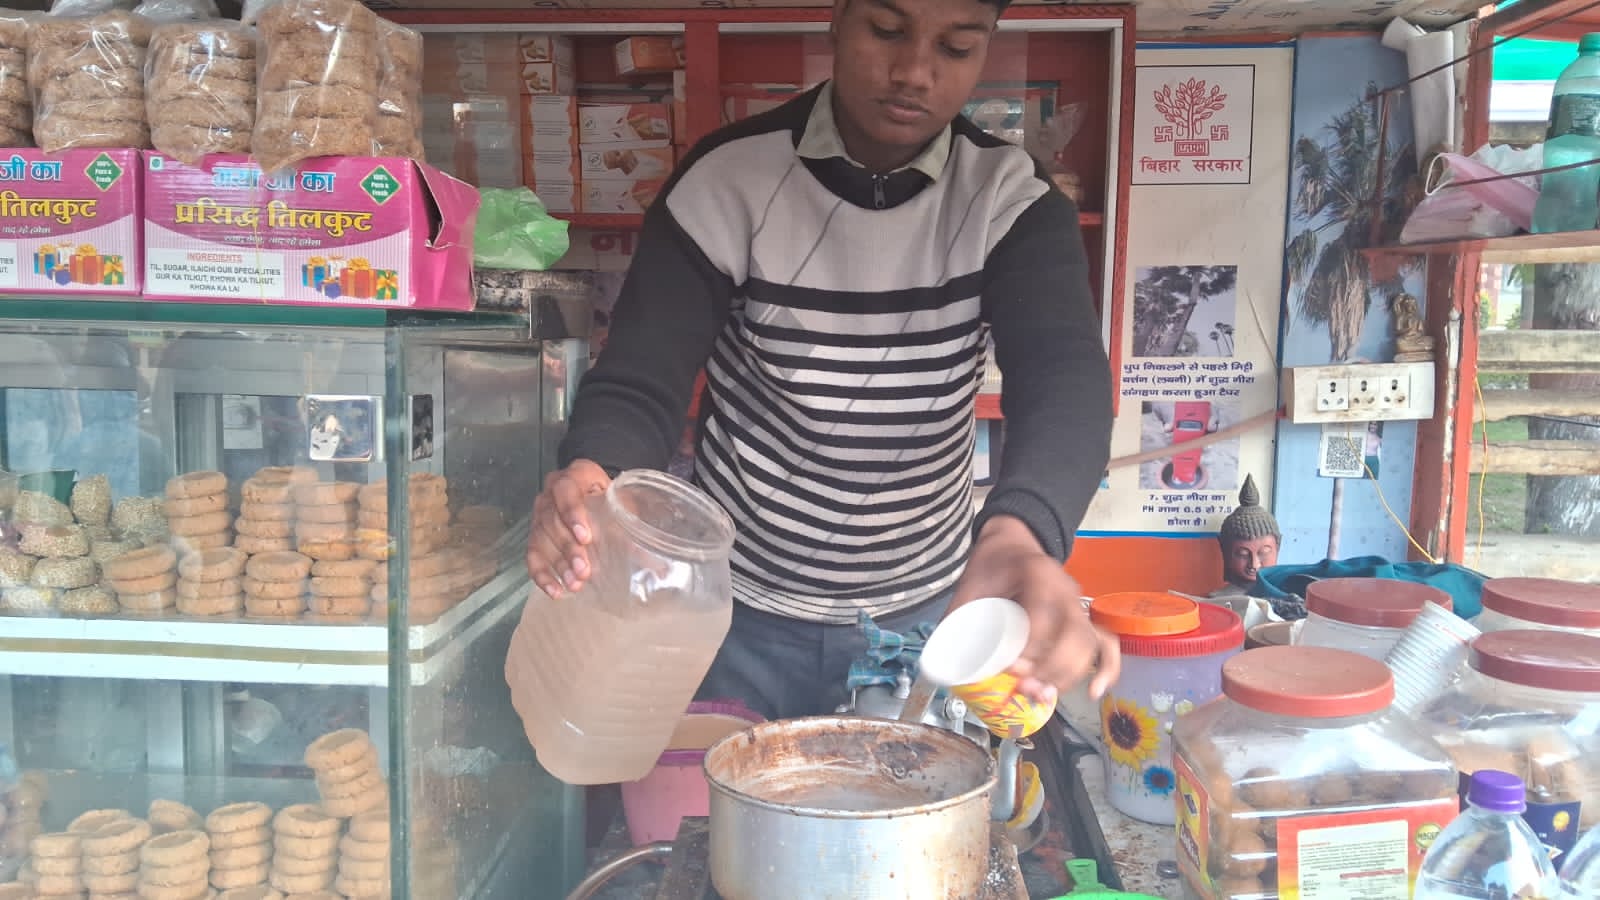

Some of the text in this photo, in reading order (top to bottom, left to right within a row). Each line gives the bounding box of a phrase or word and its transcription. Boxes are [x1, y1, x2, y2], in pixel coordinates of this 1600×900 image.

[1140, 156, 1243, 173] बिहार सरकार
[30, 160, 62, 181] का
[301, 171, 336, 192] का
[0, 190, 97, 224] तिलकुट
[175, 197, 373, 237] प्रसिद्ध तिलकुट
[187, 252, 242, 262] INGREDIENTS
[1143, 362, 1185, 371] निकलने
[1188, 362, 1199, 371] से
[1202, 362, 1228, 371] पहले
[1196, 375, 1206, 384] में
[1233, 374, 1255, 384] नीरा
[1162, 389, 1191, 397] करता
[1194, 389, 1216, 399] हुआ
[1186, 492, 1208, 501] नीरा
[1142, 505, 1154, 513] PH
[1167, 516, 1190, 526] होता
